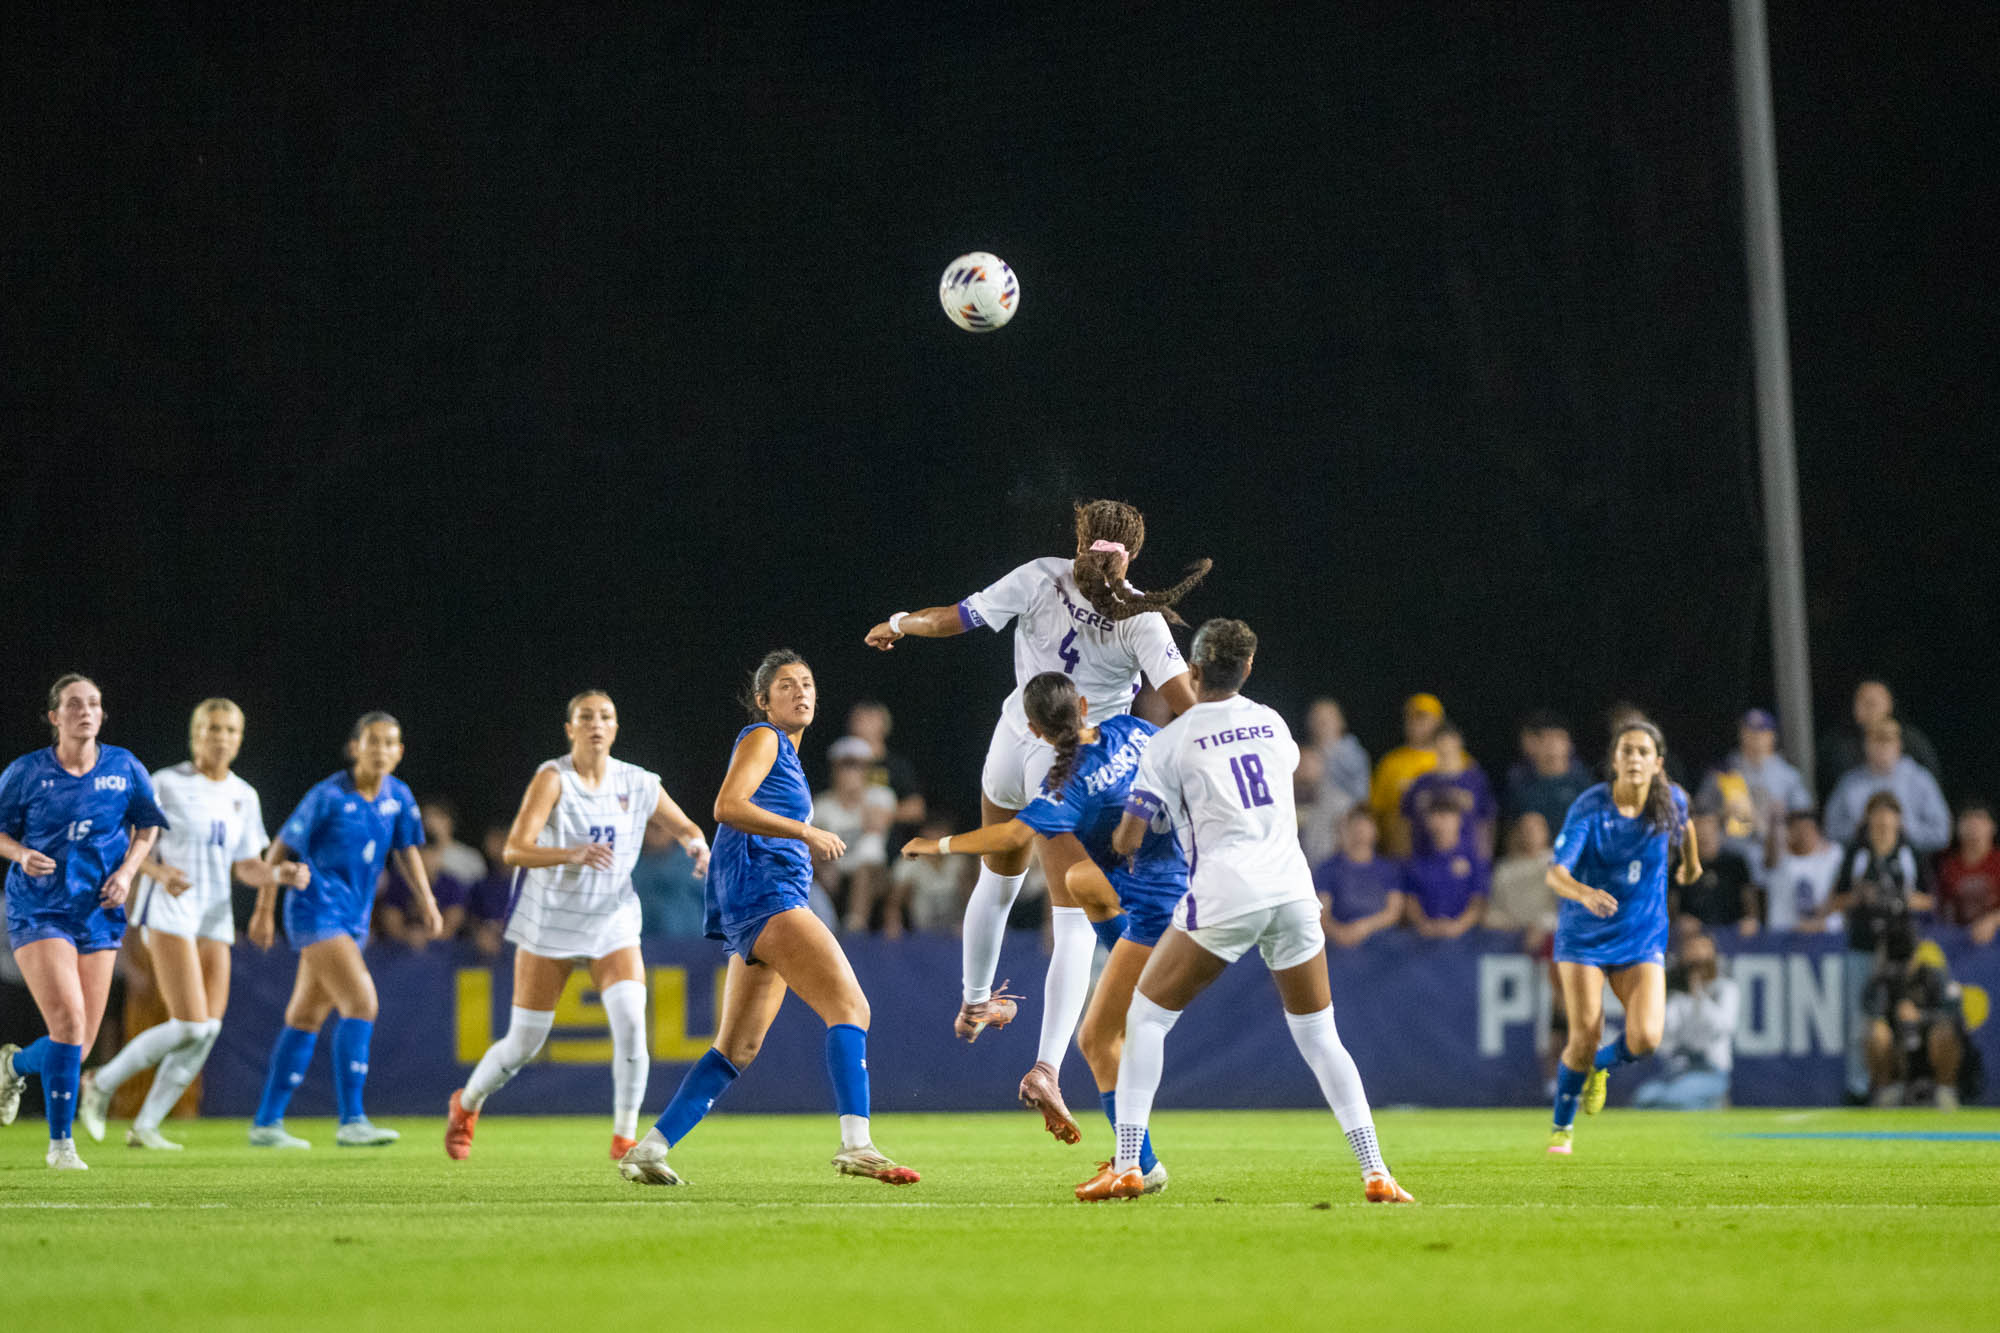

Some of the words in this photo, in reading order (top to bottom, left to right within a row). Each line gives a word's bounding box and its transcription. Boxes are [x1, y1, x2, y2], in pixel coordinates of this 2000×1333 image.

[1058, 626, 1080, 674] 4
[1193, 725, 1274, 750] TIGERS
[94, 775, 126, 792] HCU
[1229, 753, 1274, 809] 18
[67, 819, 93, 841] 15
[1627, 860, 1642, 885] 8
[456, 966, 728, 1063] LSU
